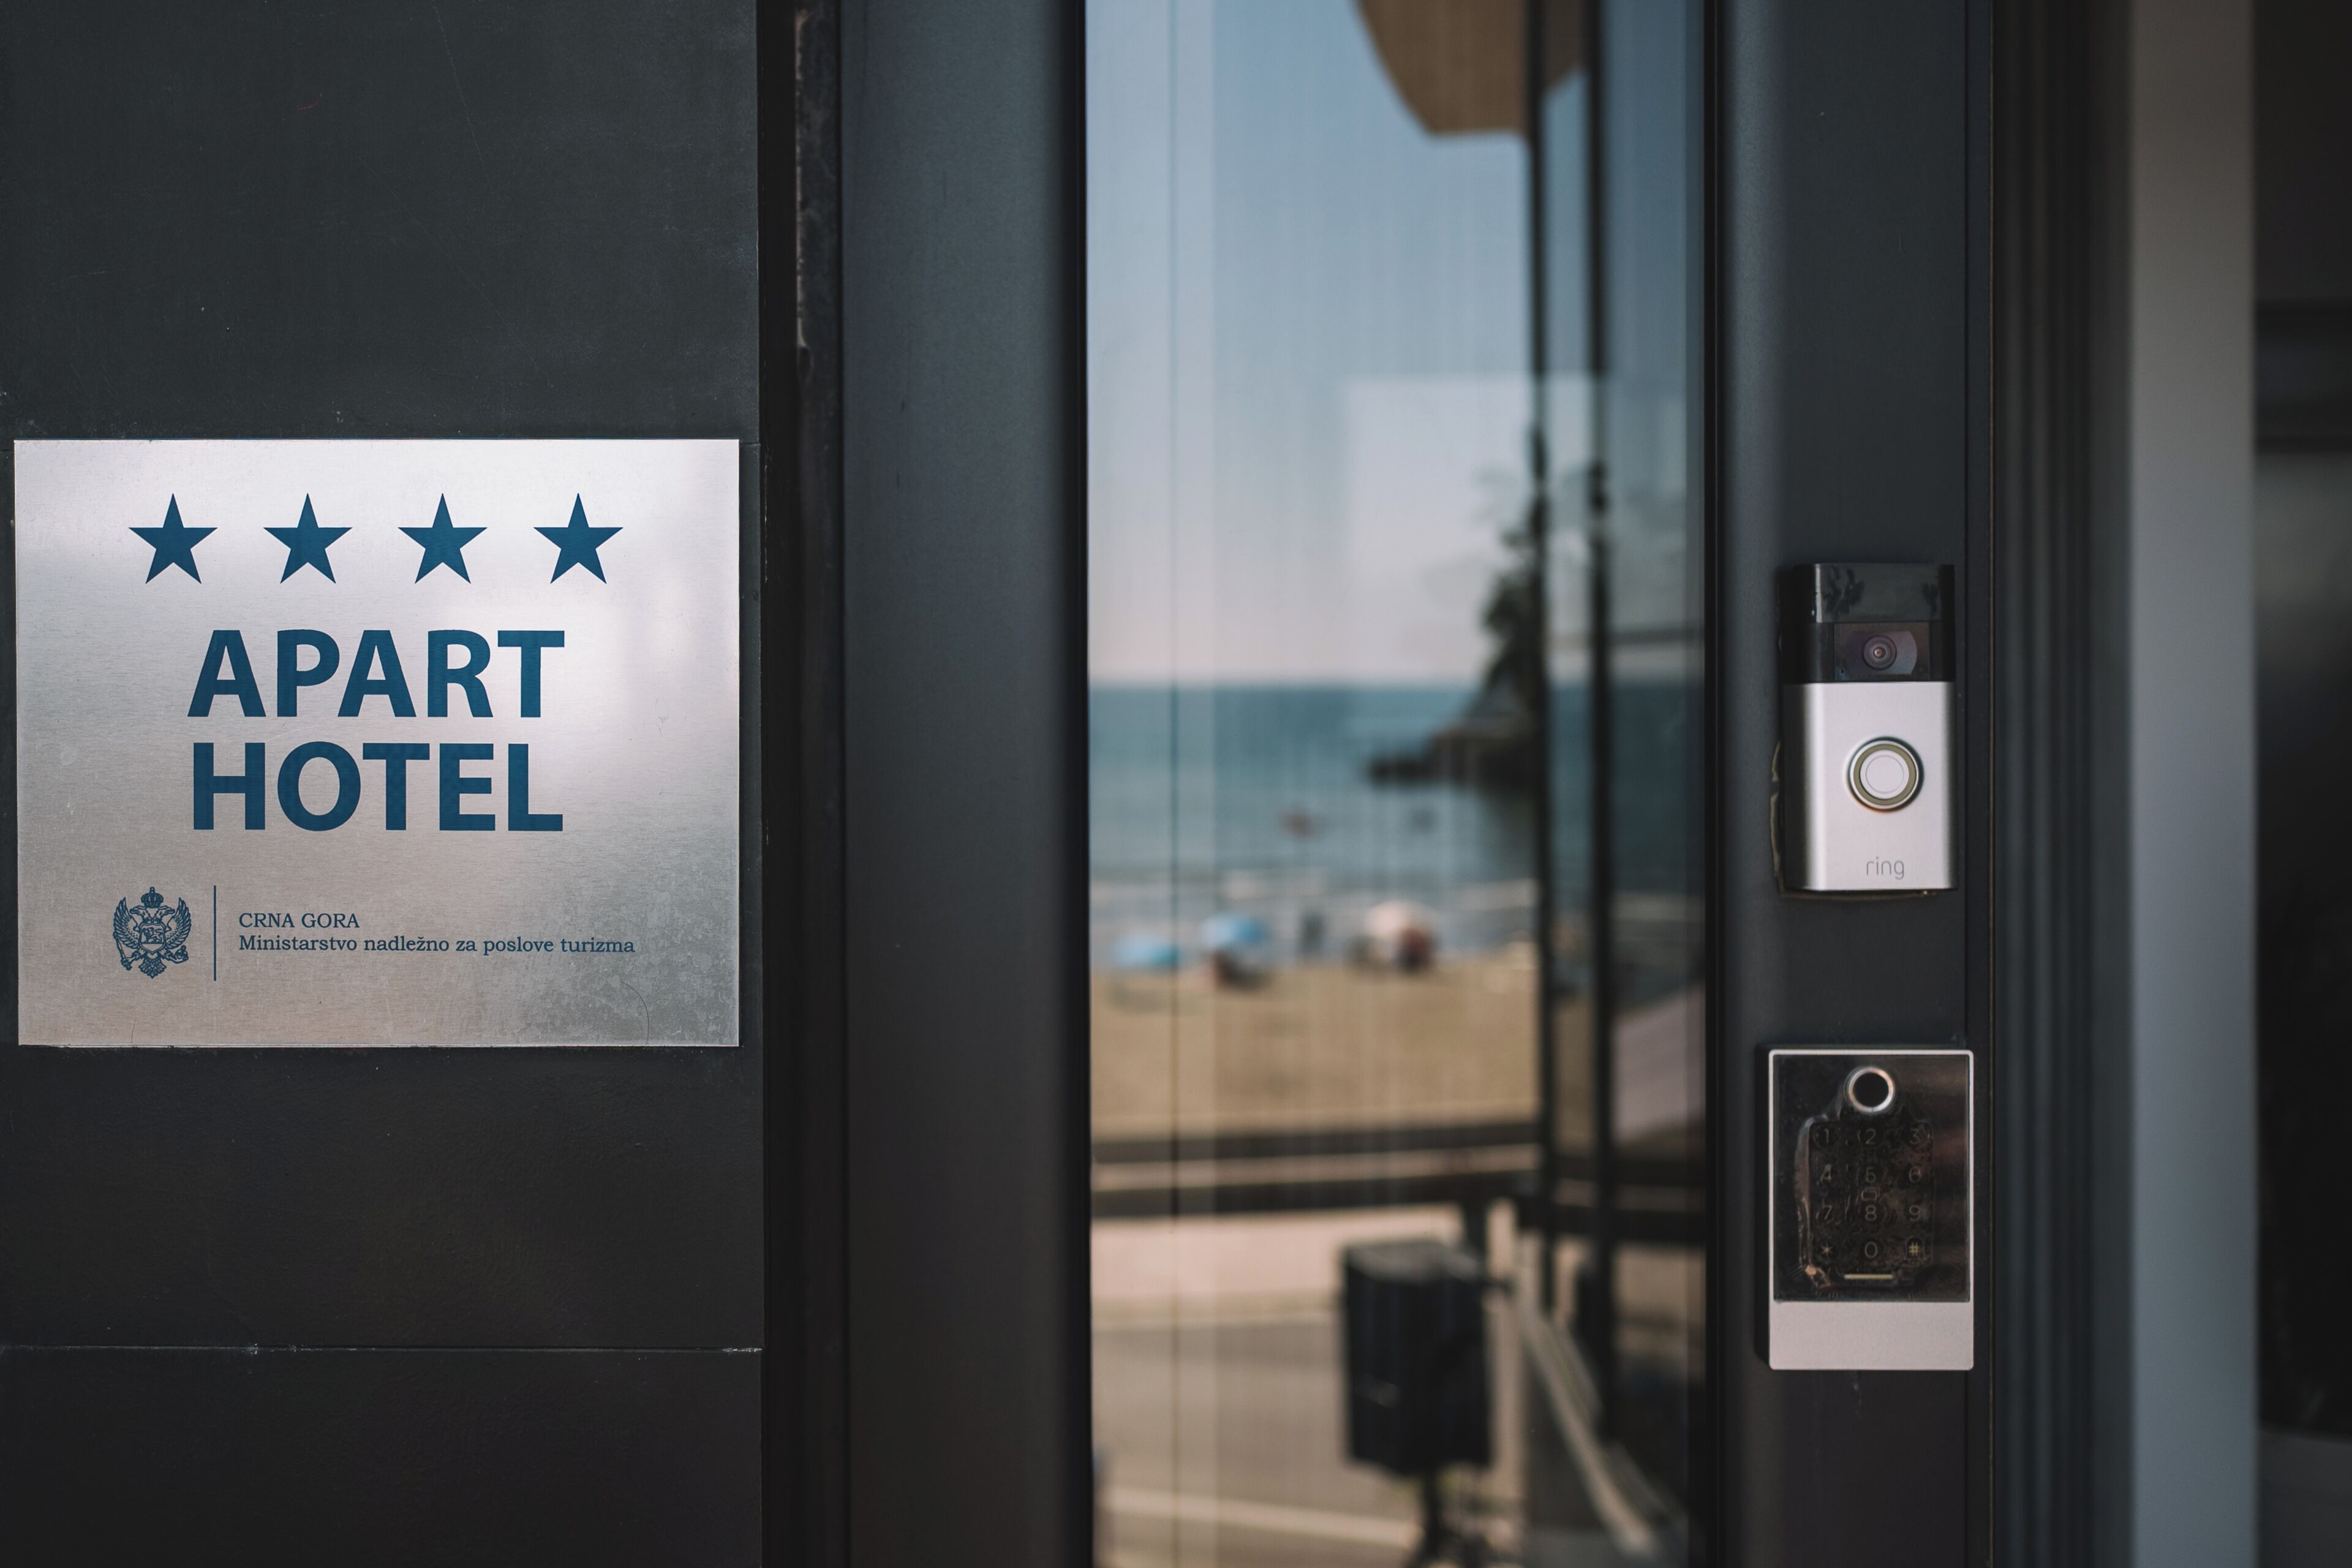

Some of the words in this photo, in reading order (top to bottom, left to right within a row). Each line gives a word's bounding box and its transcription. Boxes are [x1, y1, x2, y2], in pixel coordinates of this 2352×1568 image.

[187, 629, 565, 718] APART
[194, 742, 564, 832] HOTEL
[1866, 856, 1905, 880] ring
[239, 913, 295, 929] CRNA
[301, 913, 360, 929] GORA
[239, 935, 358, 952] Ministarstvo
[364, 935, 450, 952] nadležno
[456, 941, 478, 952] za
[483, 937, 554, 957] poslove
[560, 937, 636, 954] turizma
[1865, 1128, 1877, 1145] 2
[1909, 1128, 1920, 1145] 3
[1820, 1166, 1833, 1183] 4
[1865, 1166, 1877, 1183] 5
[1909, 1166, 1921, 1183] 6
[1822, 1204, 1833, 1221] 7
[1864, 1204, 1877, 1221] 8
[1909, 1204, 1920, 1221] 9
